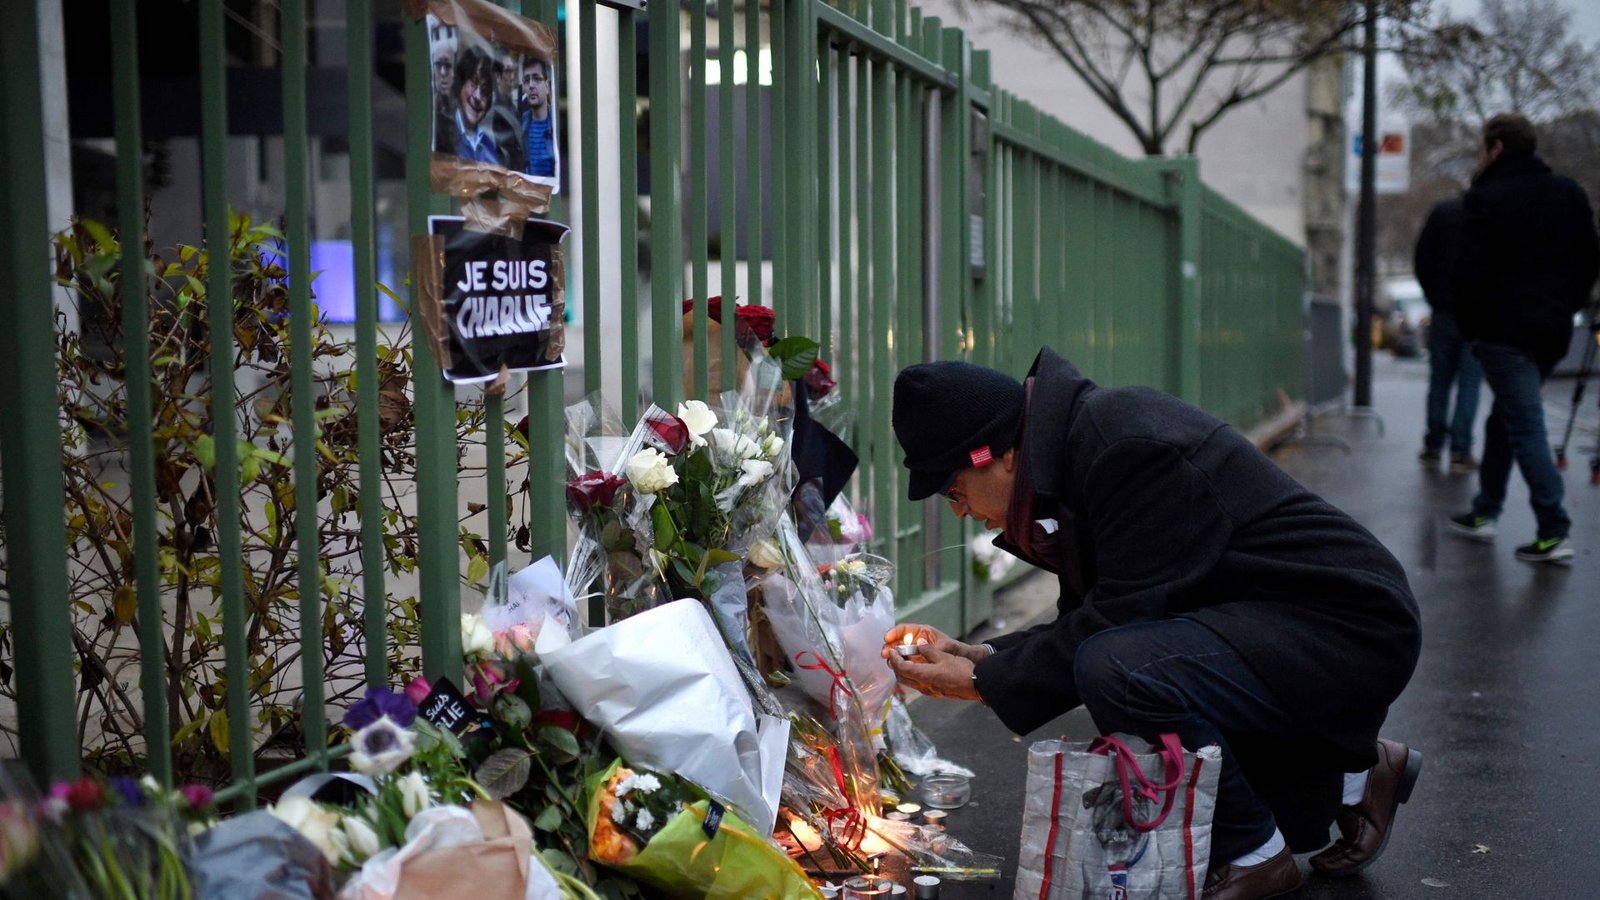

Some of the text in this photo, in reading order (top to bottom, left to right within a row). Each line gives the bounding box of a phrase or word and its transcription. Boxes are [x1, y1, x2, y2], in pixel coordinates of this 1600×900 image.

[457, 260, 548, 292] JE SUIS
[456, 294, 552, 339] CHARLIE
